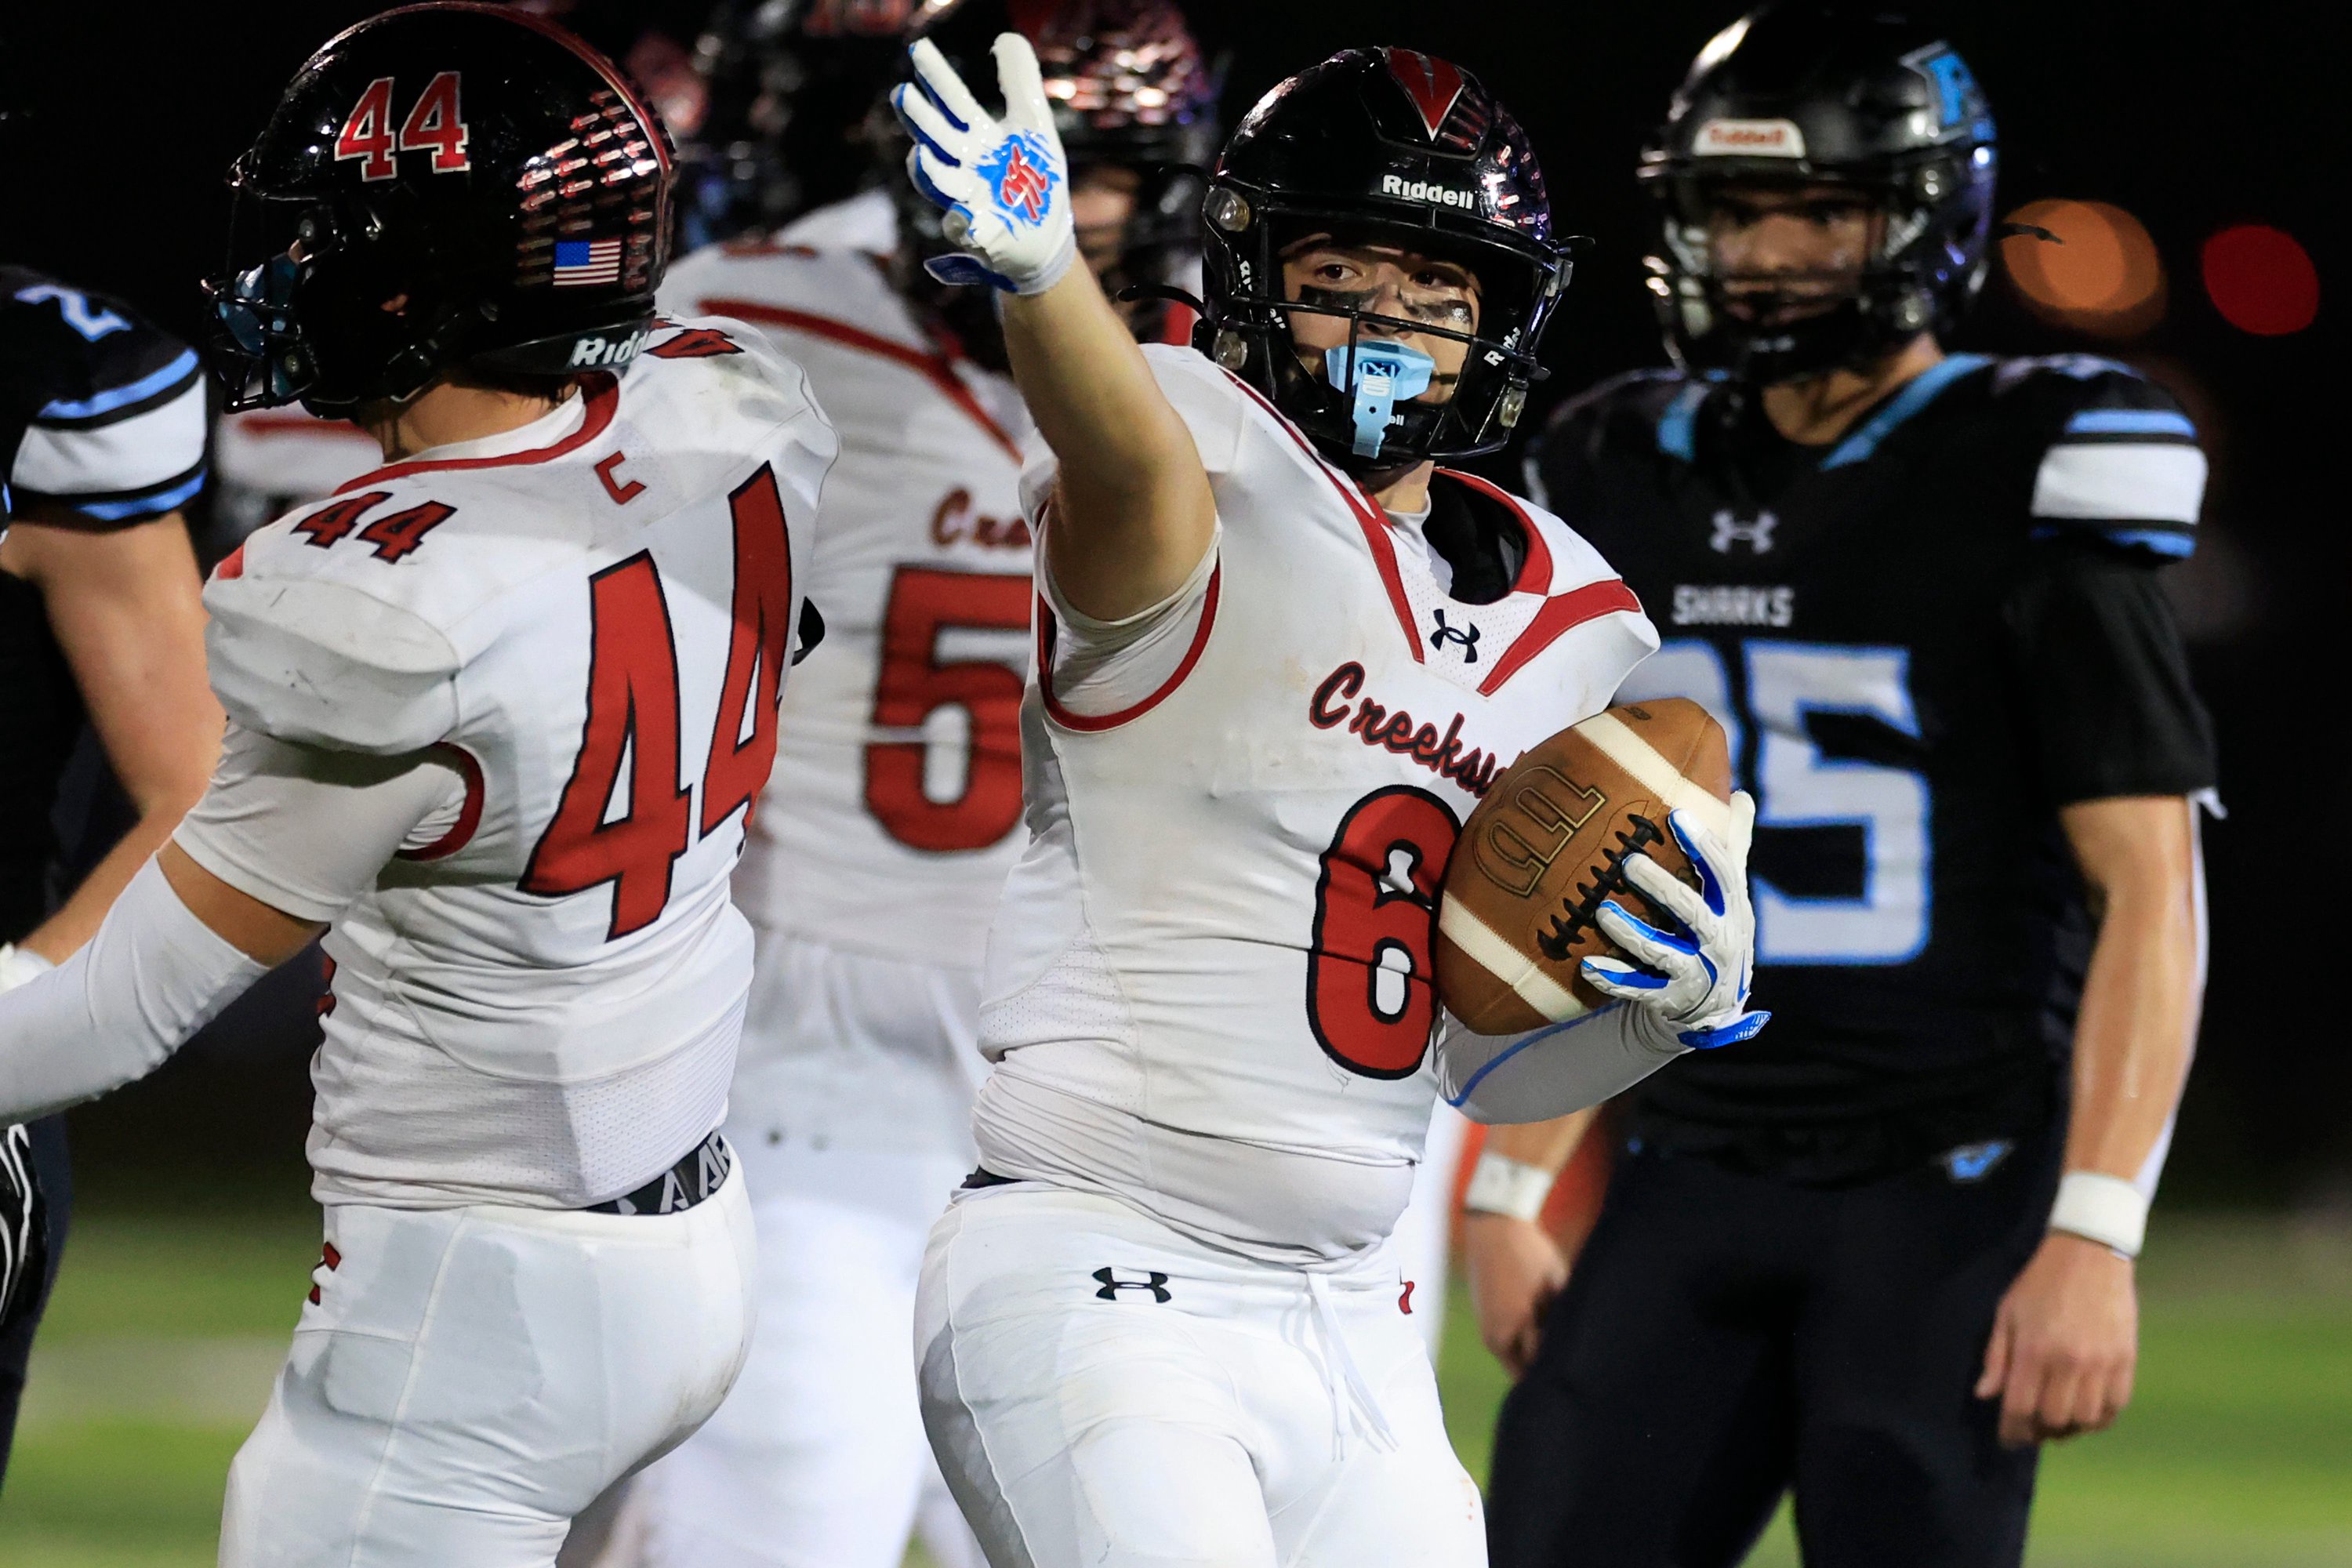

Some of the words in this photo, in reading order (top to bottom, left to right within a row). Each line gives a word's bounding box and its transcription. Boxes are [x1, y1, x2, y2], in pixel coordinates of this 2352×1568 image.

[334, 71, 470, 182] 44
[1381, 174, 1474, 210] Riddell
[594, 451, 646, 505] C
[290, 491, 458, 564] 44
[1671, 585, 1795, 627] SHARKS
[515, 459, 793, 944] 44
[1305, 784, 1463, 1080] 6
